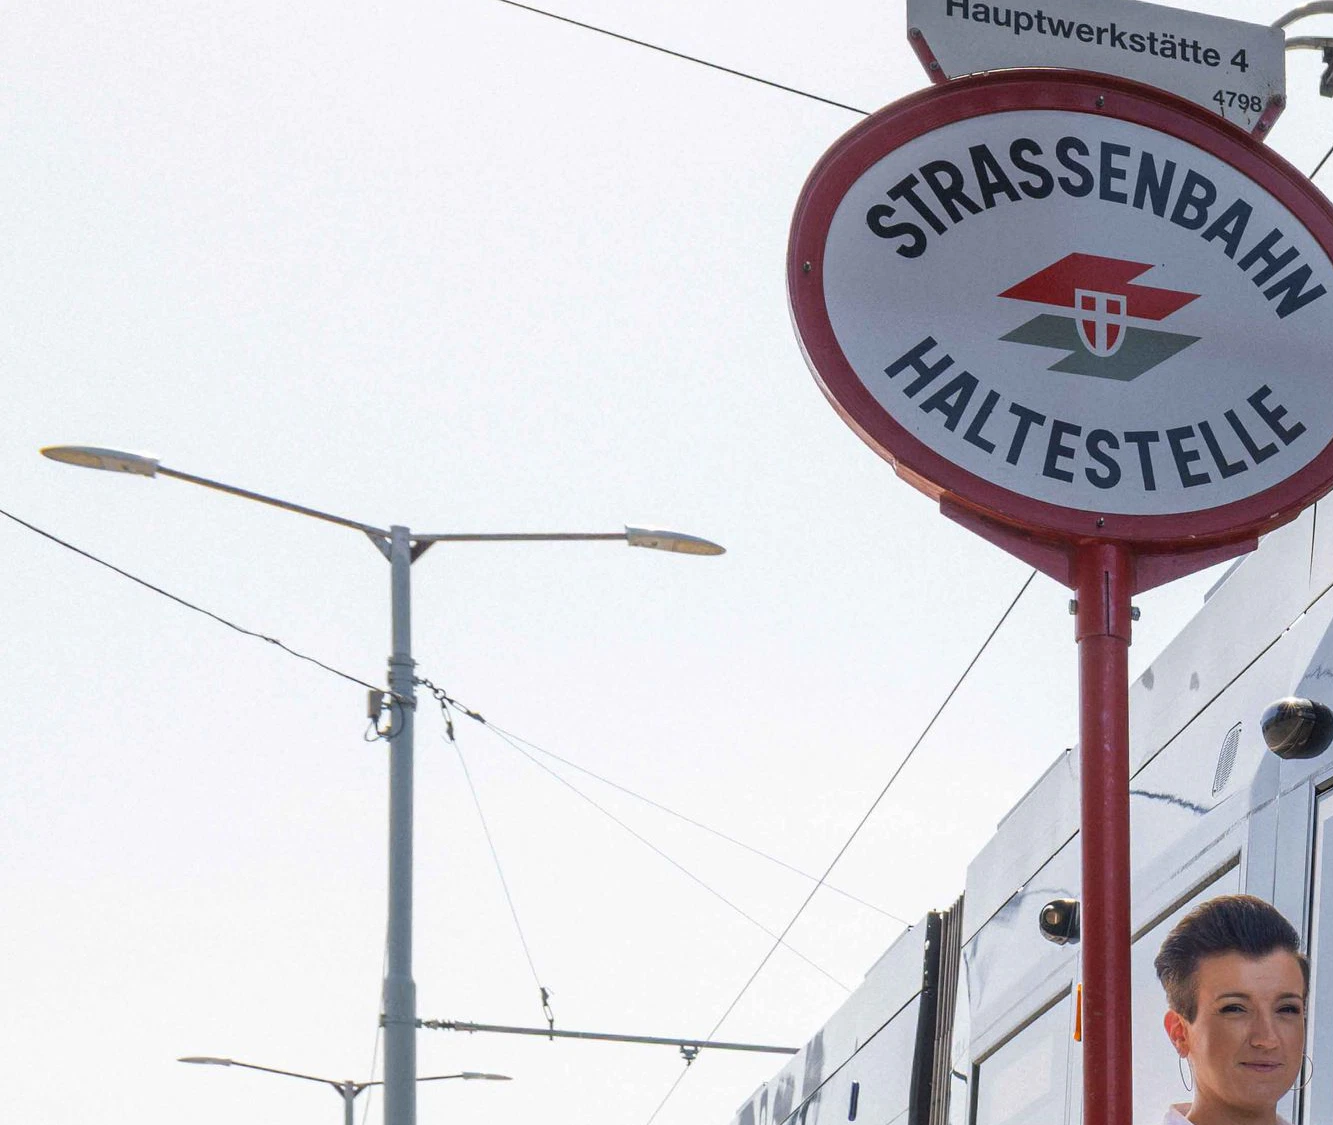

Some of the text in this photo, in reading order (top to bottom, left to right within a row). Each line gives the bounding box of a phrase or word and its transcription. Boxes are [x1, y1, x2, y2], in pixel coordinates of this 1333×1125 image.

[946, 0, 1249, 73] Hauptwerkstätte 4
[1212, 89, 1263, 113] 4798
[866, 135, 1327, 320] STRASSENBAHN
[885, 335, 1307, 492] HALTESTELLE
